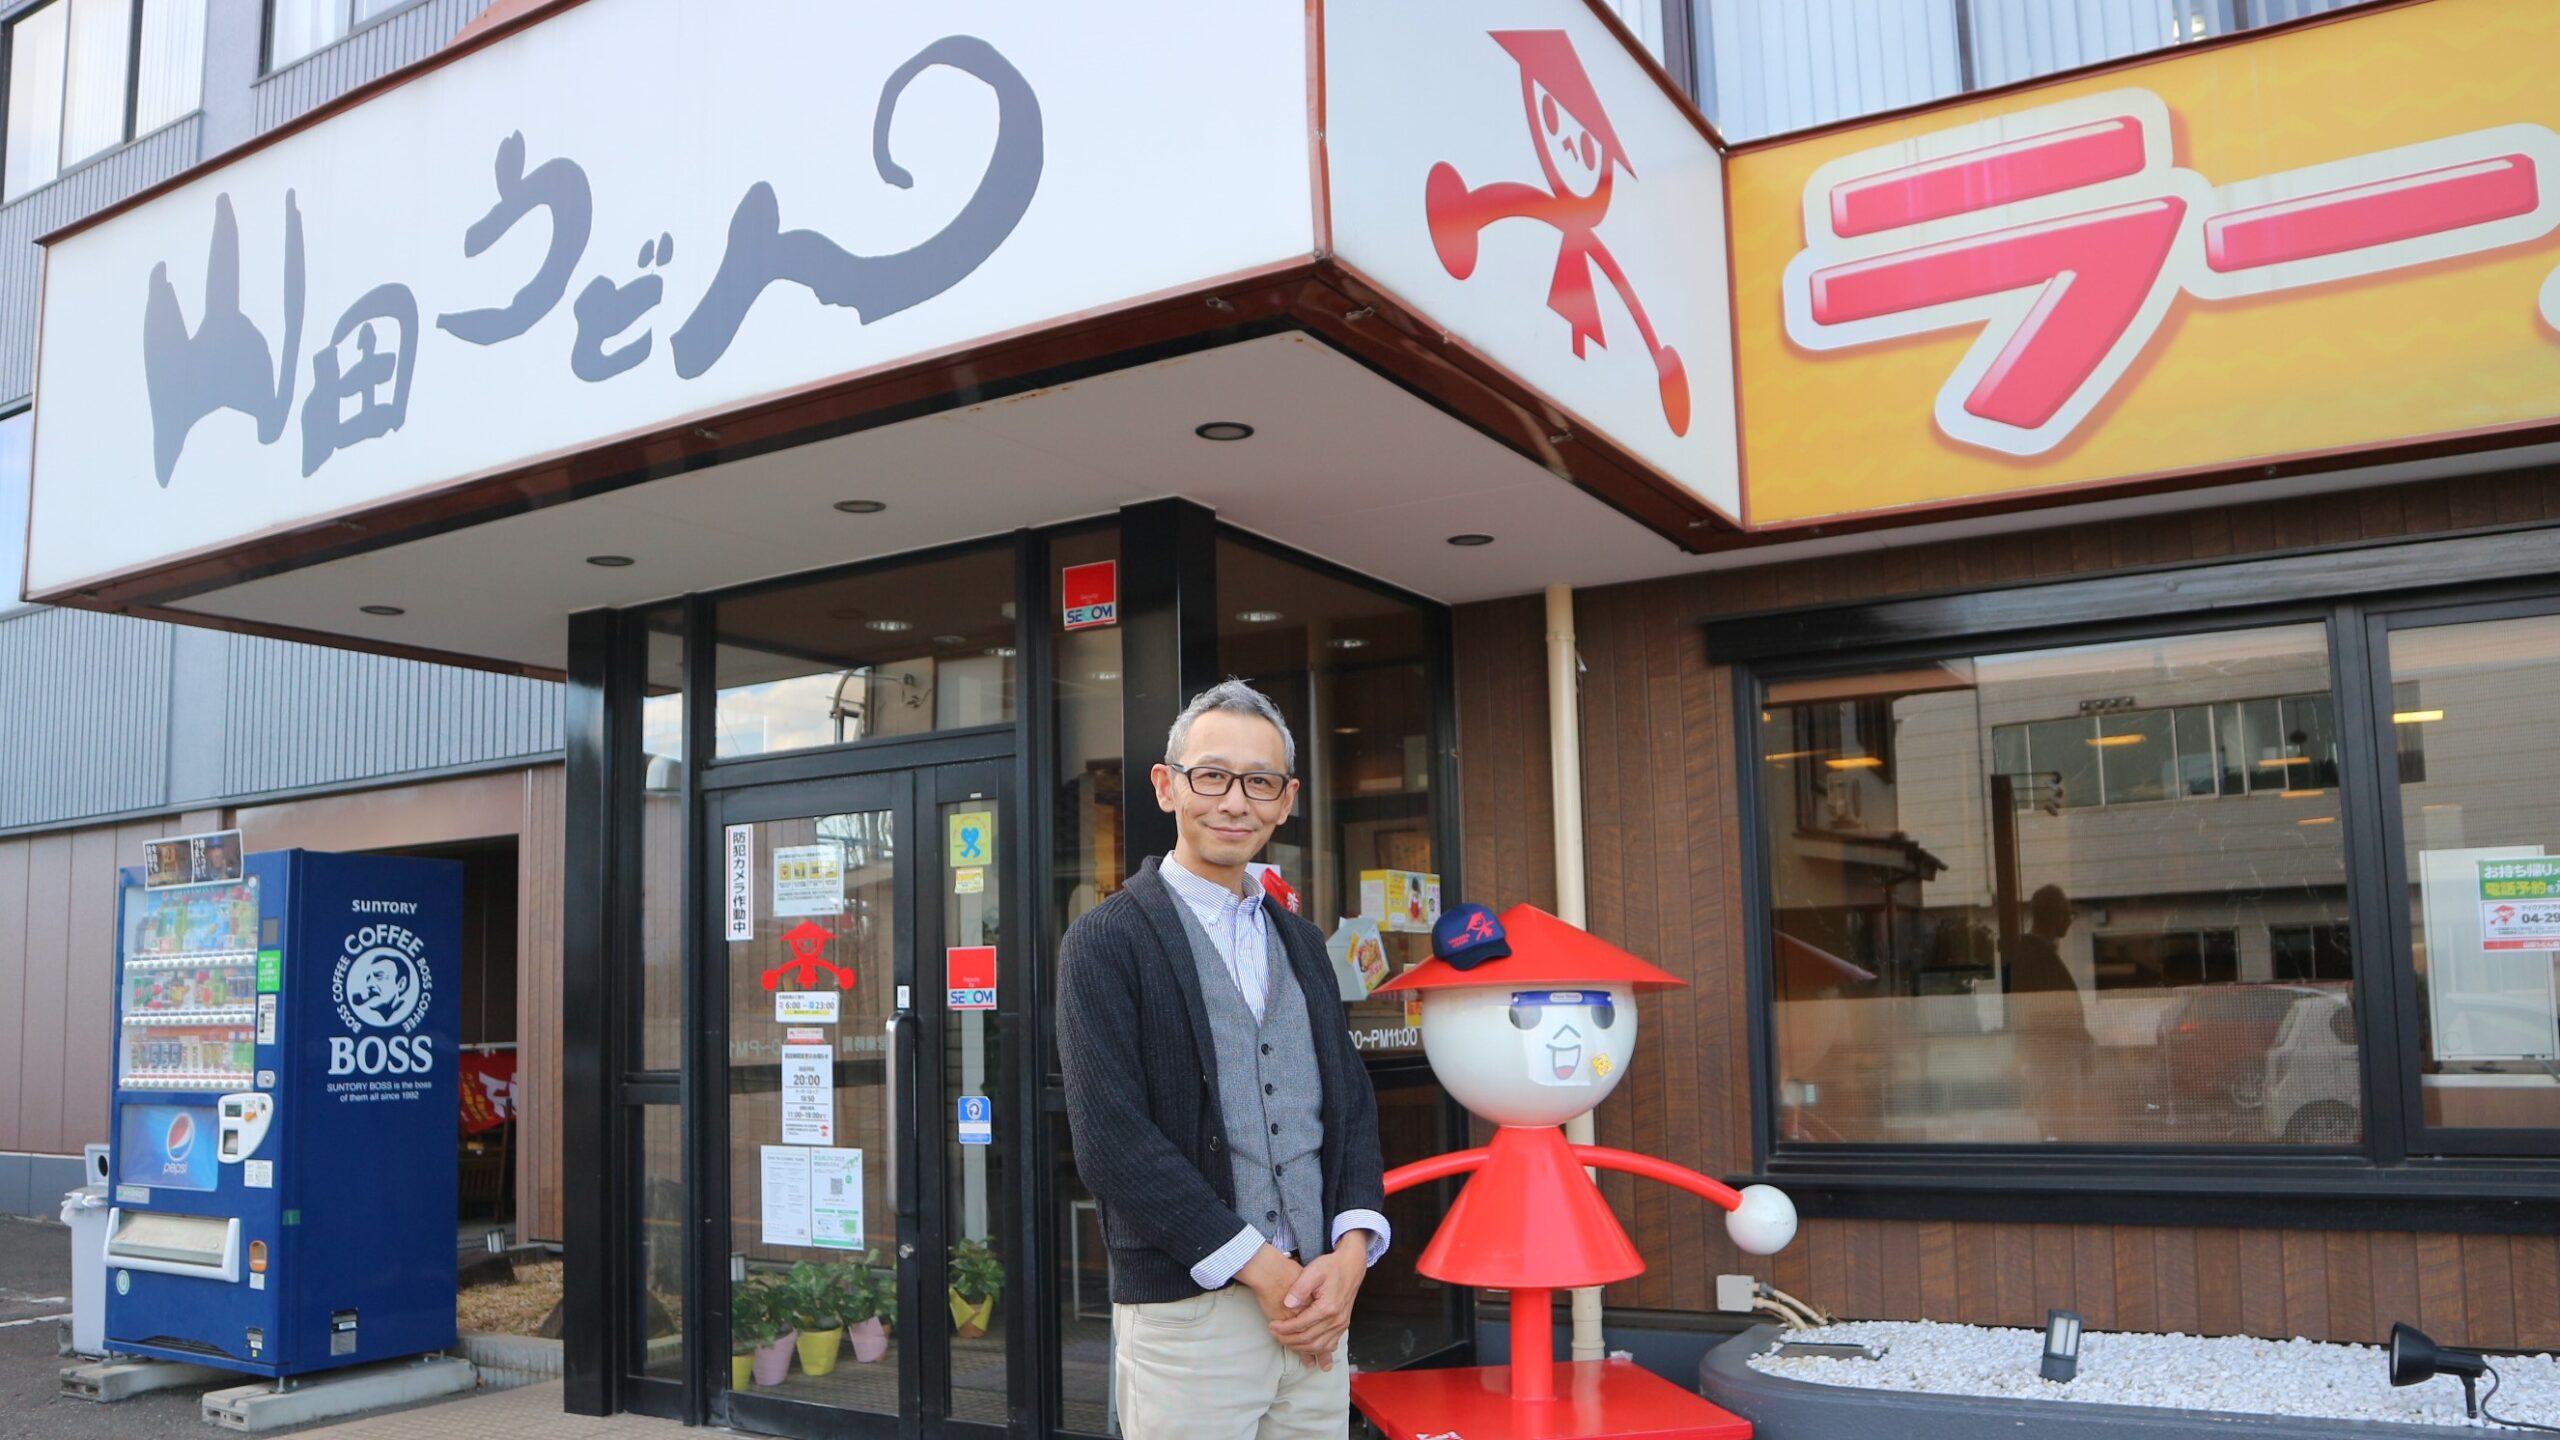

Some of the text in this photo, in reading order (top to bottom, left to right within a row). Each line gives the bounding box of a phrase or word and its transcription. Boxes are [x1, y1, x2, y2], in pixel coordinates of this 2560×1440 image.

[144, 34, 1044, 487] 山田うどん
[1785, 88, 2560, 456] ラー
[1066, 604, 1113, 624] SECOM
[732, 831, 747, 933] 防犯カメラ作動中
[351, 899, 418, 914] SUNTORY
[344, 923, 425, 957] COFFEE
[332, 955, 362, 1034] BOSS COFFEE
[402, 957, 432, 1033] BOSS COFFEE
[950, 990, 993, 1004] SECOM
[327, 1035, 433, 1075] BOSS
[326, 1082, 368, 1092] SUNTORY
[369, 1081, 392, 1091] BOSS
[401, 1081, 414, 1089] the
[793, 1074, 821, 1086] 20:00
[339, 1093, 348, 1103] of
[349, 1092, 368, 1101] them
[369, 1092, 380, 1101] all
[380, 1091, 400, 1100] since
[162, 1162, 188, 1175] pepsi
